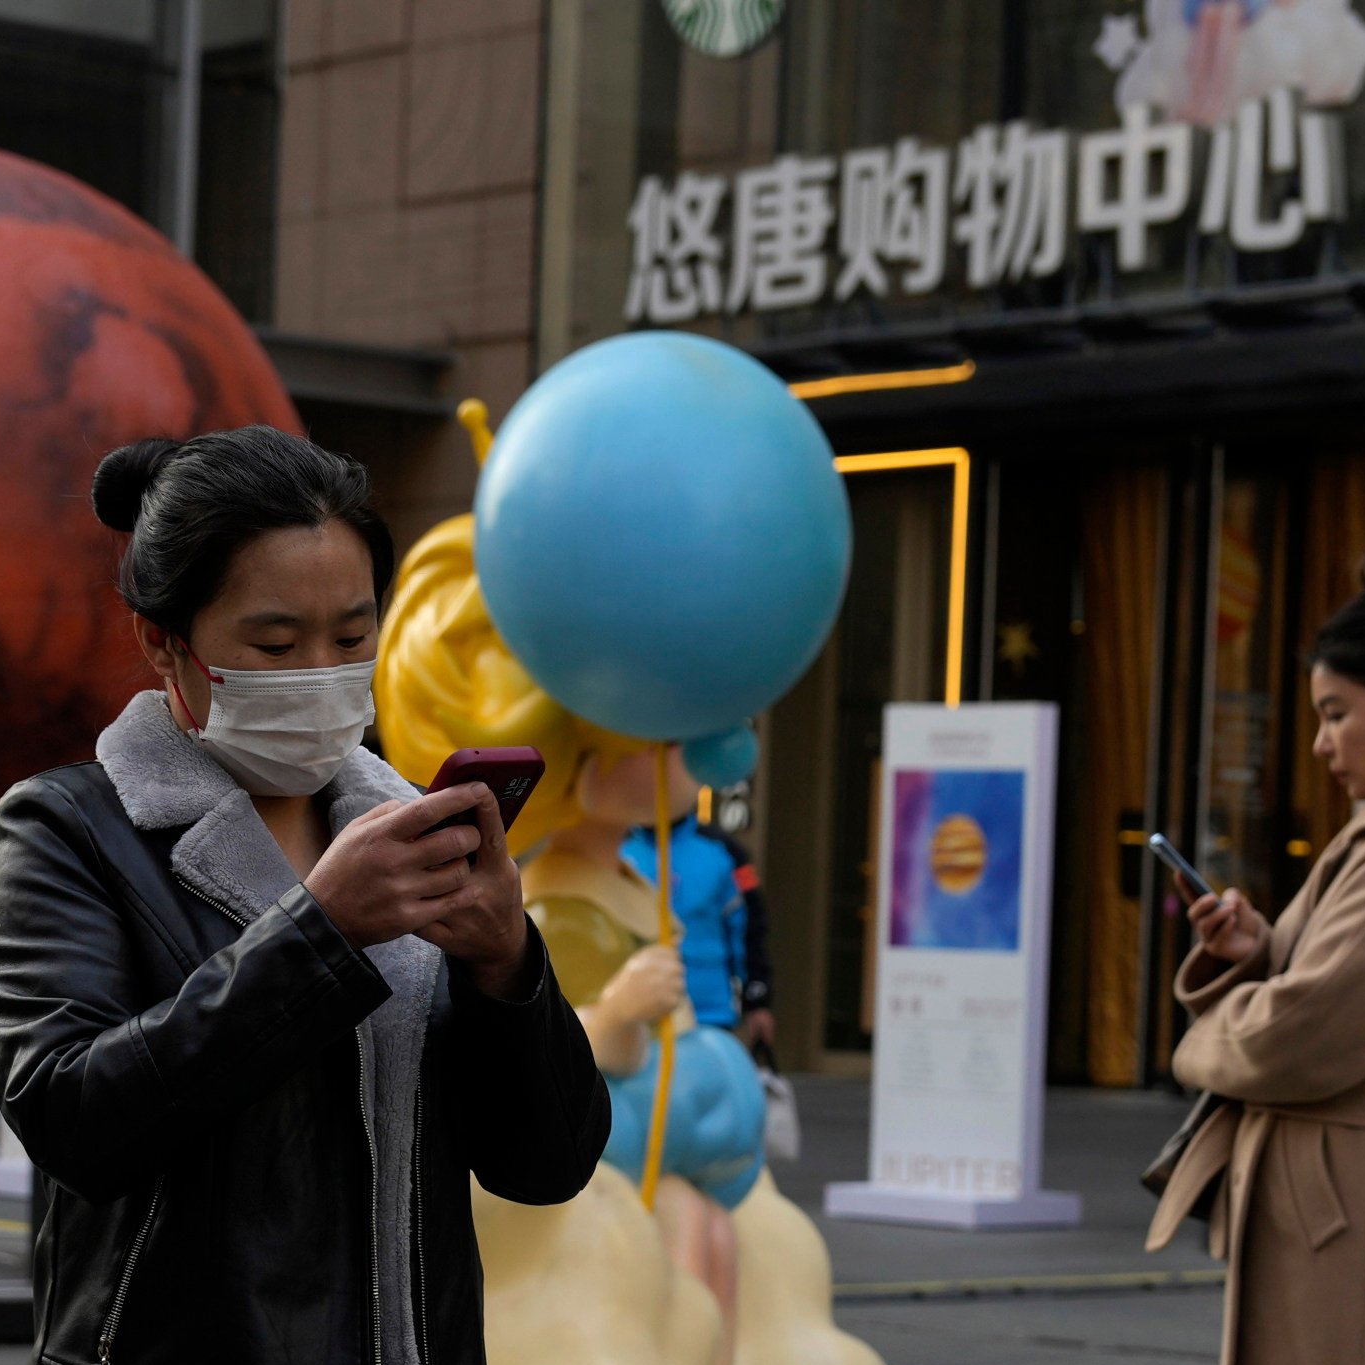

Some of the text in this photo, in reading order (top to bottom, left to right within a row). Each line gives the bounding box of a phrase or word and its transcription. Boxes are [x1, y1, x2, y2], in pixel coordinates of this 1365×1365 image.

[623, 82, 1343, 324] 悠唐购物中心
